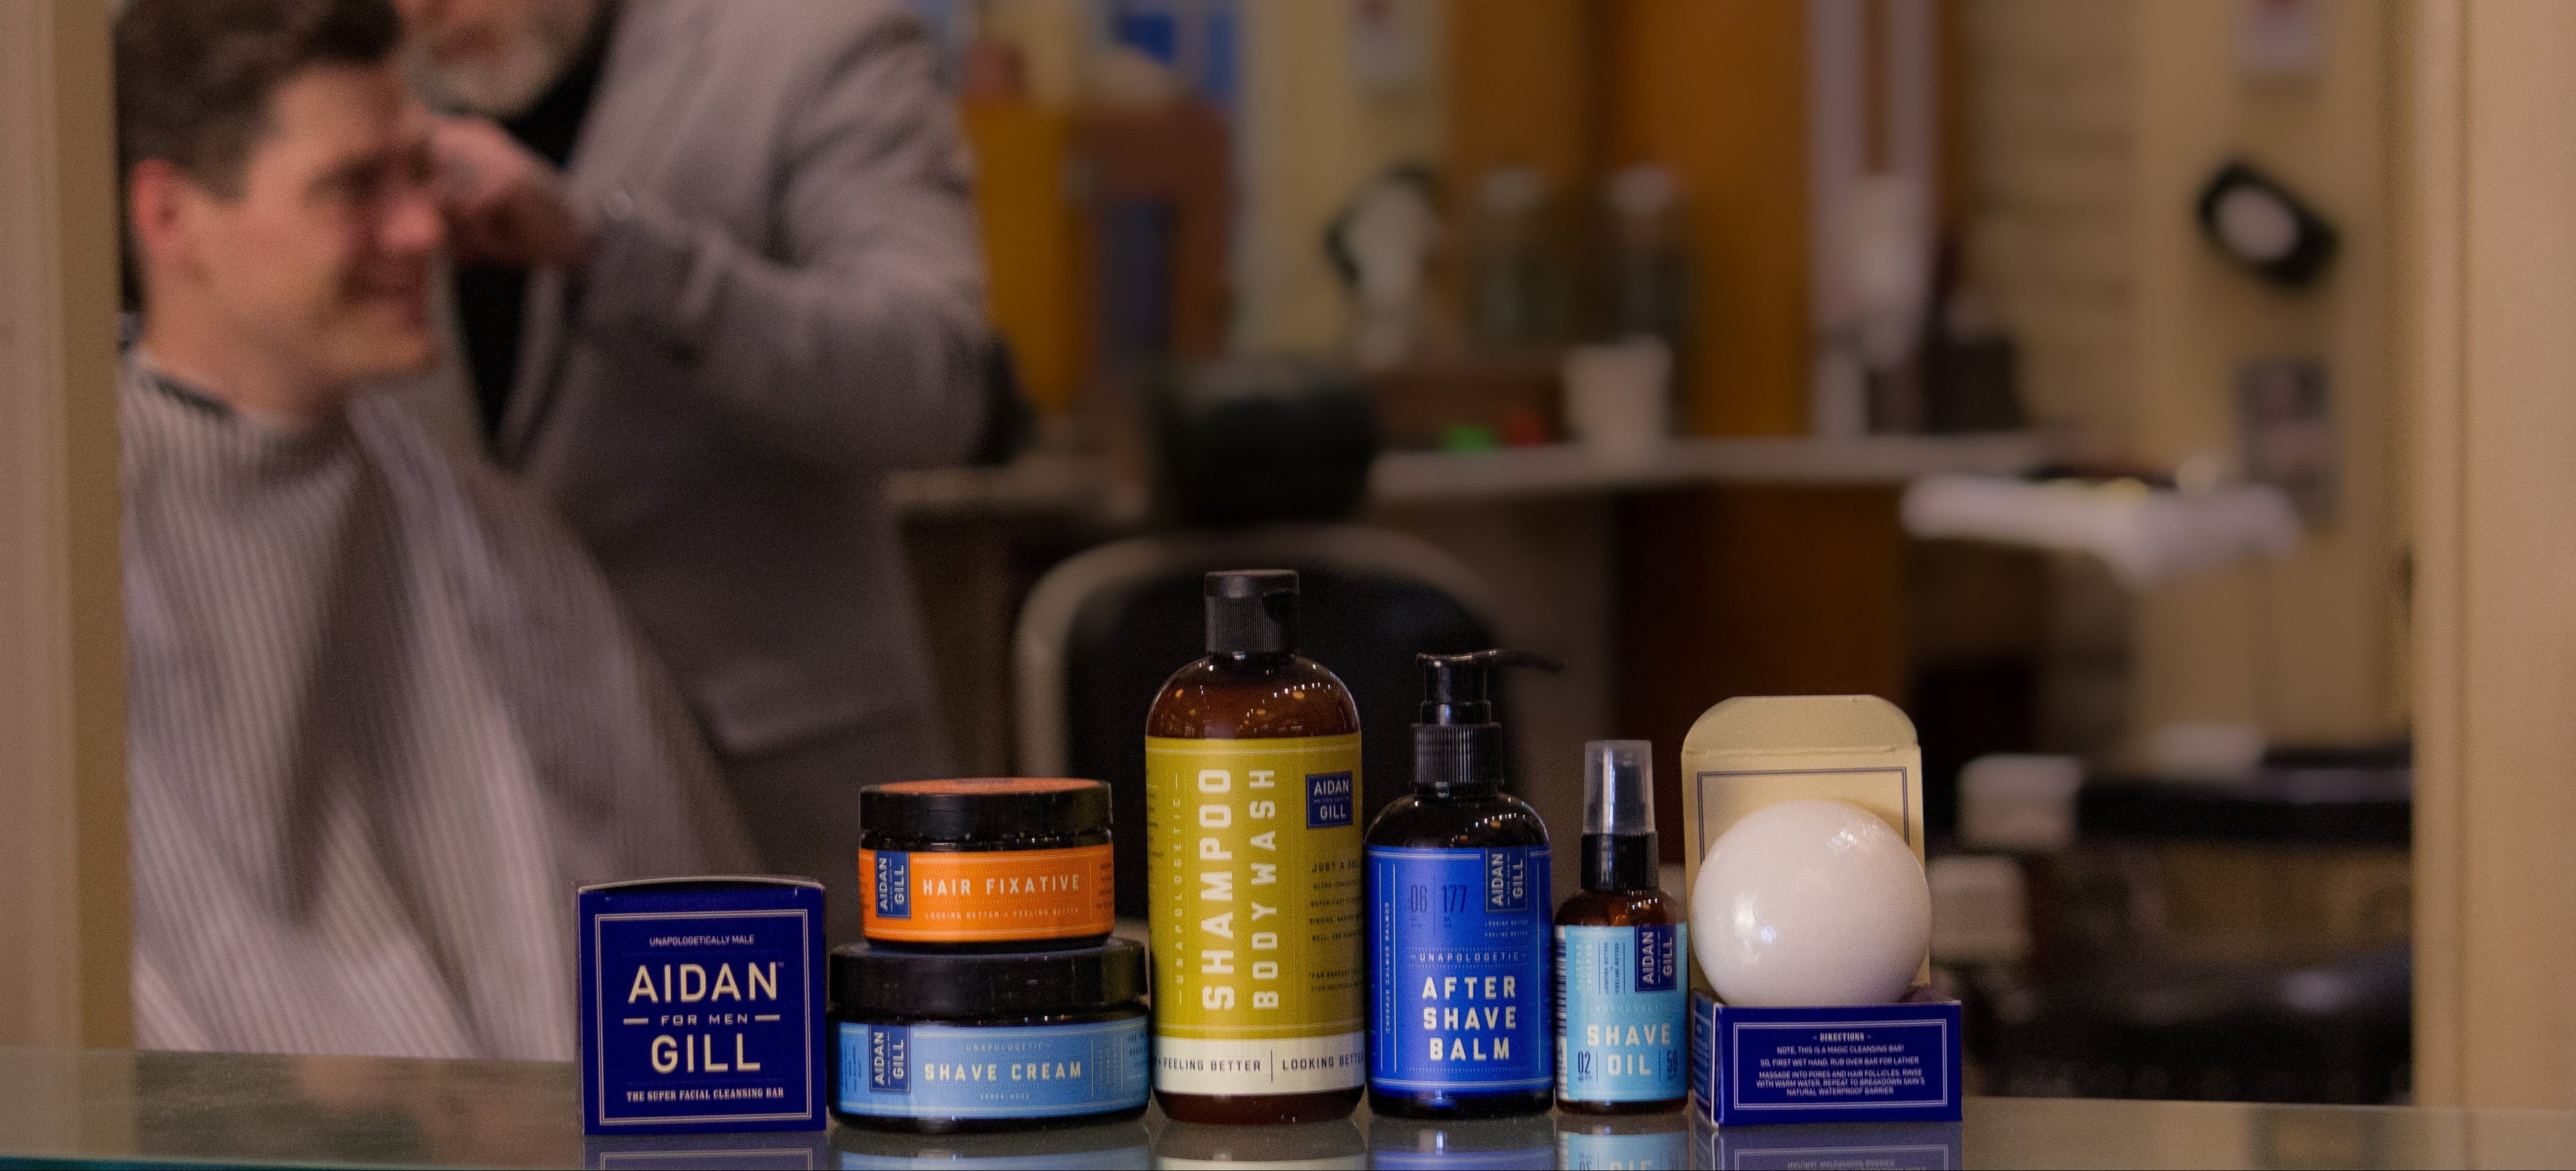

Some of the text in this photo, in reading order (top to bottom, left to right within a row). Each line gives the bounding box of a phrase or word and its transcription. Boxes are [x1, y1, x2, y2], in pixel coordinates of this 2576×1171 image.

[1313, 779, 1349, 797] AIDAN
[1320, 803, 1346, 820] GILL
[879, 858, 888, 911] AIDAN
[894, 865, 904, 905] GILL
[923, 874, 1079, 896] HAIR FIXATIVE
[1198, 769, 1234, 1009] SHAMPOO
[1491, 853, 1503, 906] AIDAN
[1513, 859, 1523, 899] GILL
[1173, 798, 1183, 984] UNAPOLOGETIC
[1410, 884, 1428, 912] 06
[1442, 884, 1467, 913] 177
[925, 911, 961, 919] LOOKING
[1014, 909, 1049, 917] FEELING
[649, 934, 755, 947] UNAPOLOGETICALLY MALE
[1420, 952, 1519, 964] UNAPOLOGETIC
[1642, 931, 1654, 985] AIDAN
[1663, 936, 1673, 977] GILL
[628, 962, 777, 1003] AIDAN
[1422, 976, 1515, 999] AFTER
[661, 1013, 748, 1026] FOR MEN
[1424, 1006, 1516, 1029] SHAVE
[1587, 1023, 1671, 1046] SHAVE
[1820, 1033, 1864, 1042] DIRECTIONS
[651, 1033, 760, 1074] GILL
[874, 1031, 884, 1085] AIDAN
[966, 1042, 1043, 1052] UNAPOLOGETIC
[1430, 1038, 1509, 1061] BALM
[1798, 1046, 1813, 1055] THIS
[1814, 1046, 1820, 1055] IS
[1821, 1046, 1827, 1054] A
[1827, 1045, 1848, 1054] MAGIC
[1849, 1044, 1888, 1054] CLEANSING
[893, 1040, 904, 1079] GILL
[1164, 1057, 1260, 1071] FEELING BETTER
[1283, 1056, 1334, 1071] LOOKING
[1578, 1051, 1591, 1073] 02
[1607, 1054, 1652, 1076] OIL
[1772, 1058, 1791, 1068] FIRST
[1792, 1058, 1807, 1067] WET
[1830, 1057, 1844, 1066] RUB
[1845, 1057, 1863, 1067] OVER
[1864, 1056, 1878, 1066] BAR
[1879, 1056, 1892, 1066] FOR
[1894, 1055, 1919, 1065] LATHER
[924, 1061, 1081, 1081] SHAVE CREAM
[1759, 1070, 1790, 1079] MASSAGE
[1792, 1070, 1808, 1079] INTO
[1809, 1070, 1831, 1078] PORES
[1831, 1070, 1846, 1078] AND
[1847, 1069, 1863, 1078] HAIR
[1902, 1068, 1922, 1077] RINSE
[1756, 1080, 1774, 1088] WITH
[1774, 1079, 1796, 1088] WARM
[1823, 1078, 1847, 1087] REPEAT
[1859, 1077, 1902, 1086] BREAKDOWN
[1786, 1086, 1894, 1097] NATURAL WATERPROOF BARRIER
[627, 1087, 784, 1102] THE SUPER FACIAL CLEANSING BAR
